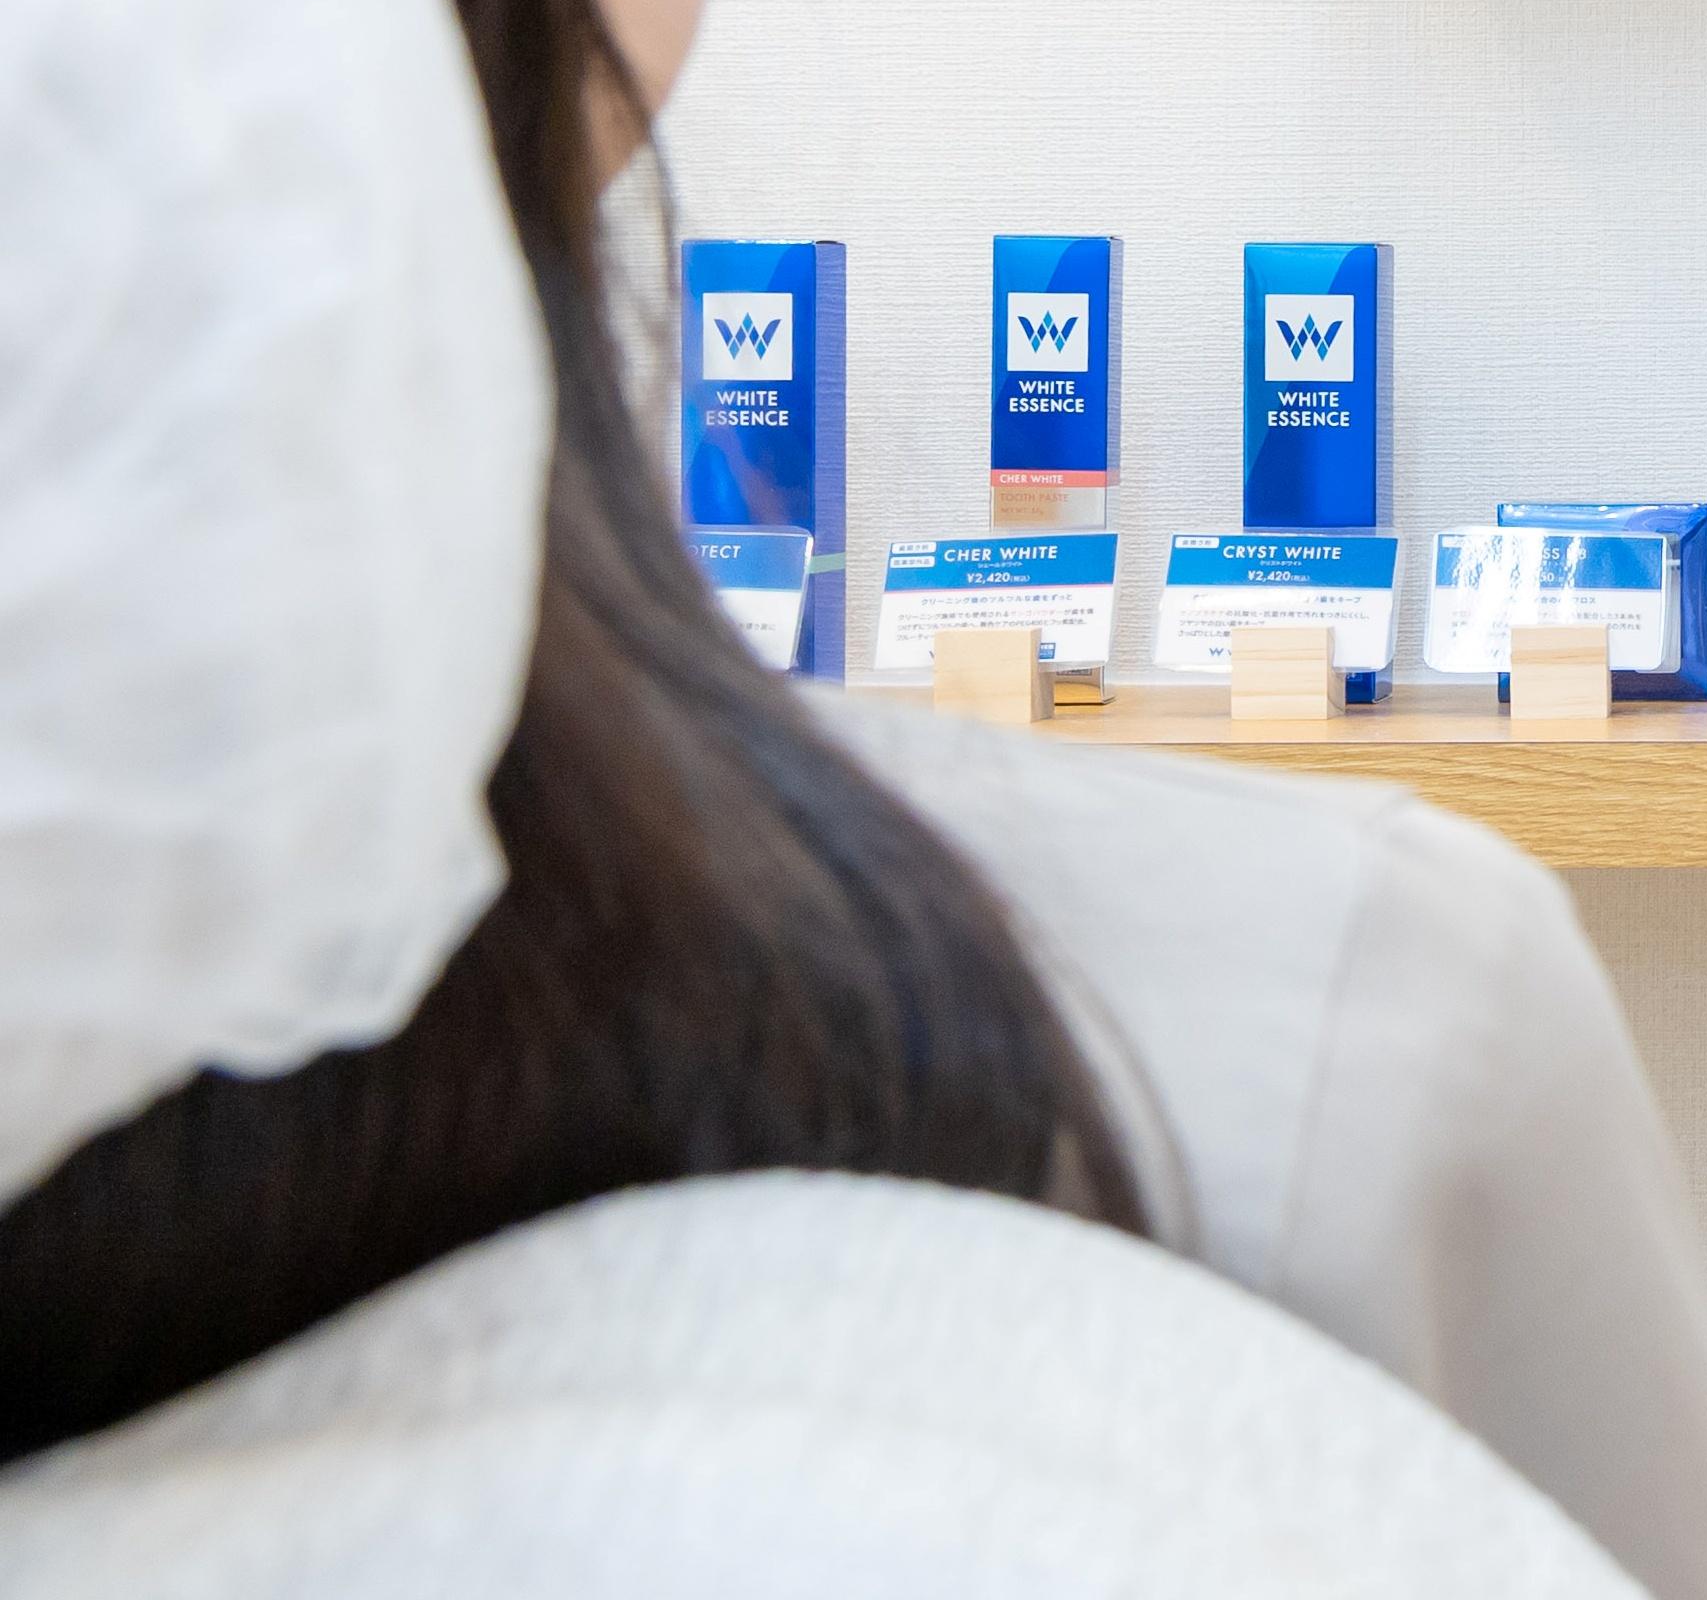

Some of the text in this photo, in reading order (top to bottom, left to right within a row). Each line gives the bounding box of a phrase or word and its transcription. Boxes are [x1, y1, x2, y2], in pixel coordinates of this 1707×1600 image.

[1018, 380, 1076, 396] WHITE
[716, 390, 778, 407] WHITE
[1008, 396, 1086, 413] ESSENCE
[1277, 391, 1340, 408] WHITE
[705, 408, 789, 427] ESSENCE
[1267, 410, 1351, 428] ESSENCE
[1000, 473, 1064, 485] CHER WHITE
[943, 545, 1059, 562] CHER WHITE
[1222, 545, 1343, 560] CRYST WHITE
